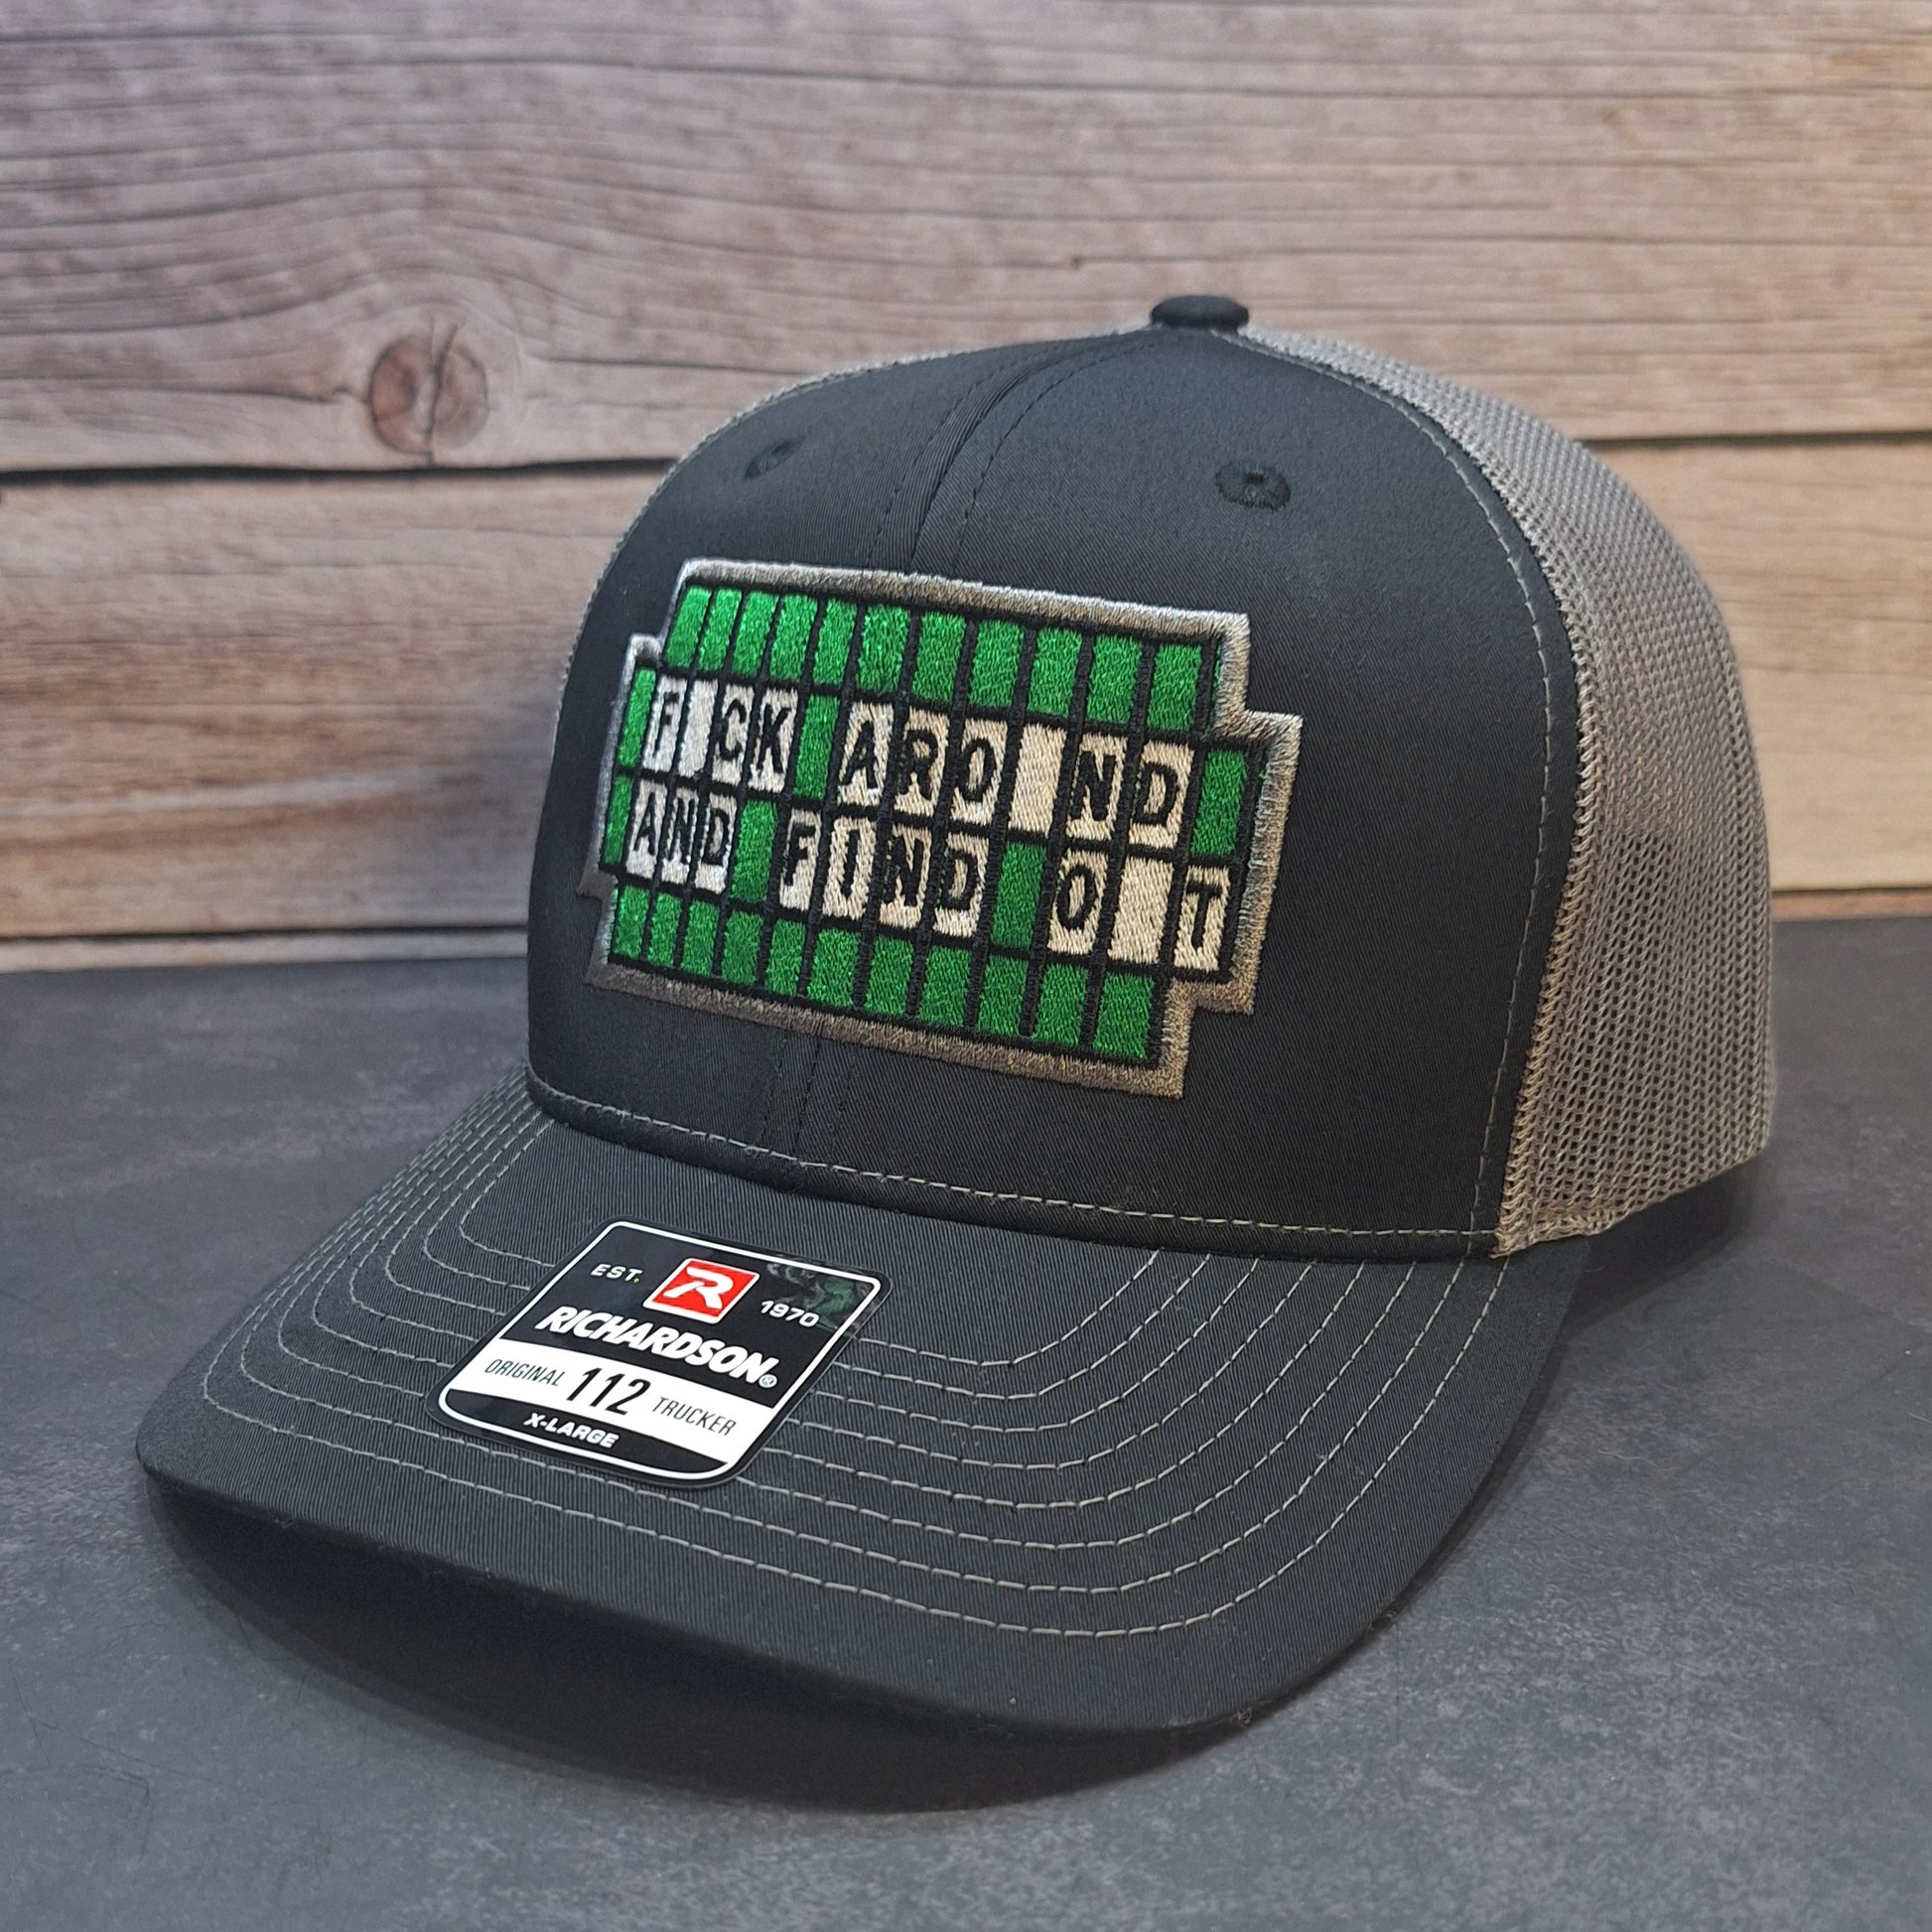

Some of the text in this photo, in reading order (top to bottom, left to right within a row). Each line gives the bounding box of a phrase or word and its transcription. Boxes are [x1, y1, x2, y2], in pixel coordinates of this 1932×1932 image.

[632, 802, 733, 867] AND
[779, 823, 979, 922] FIND
[590, 1263, 642, 1284] EST.
[760, 1300, 820, 1327] 1970
[484, 1358, 736, 1437] ORIGINAL 112 TRUCKER
[523, 1412, 619, 1449] X-LARGE
